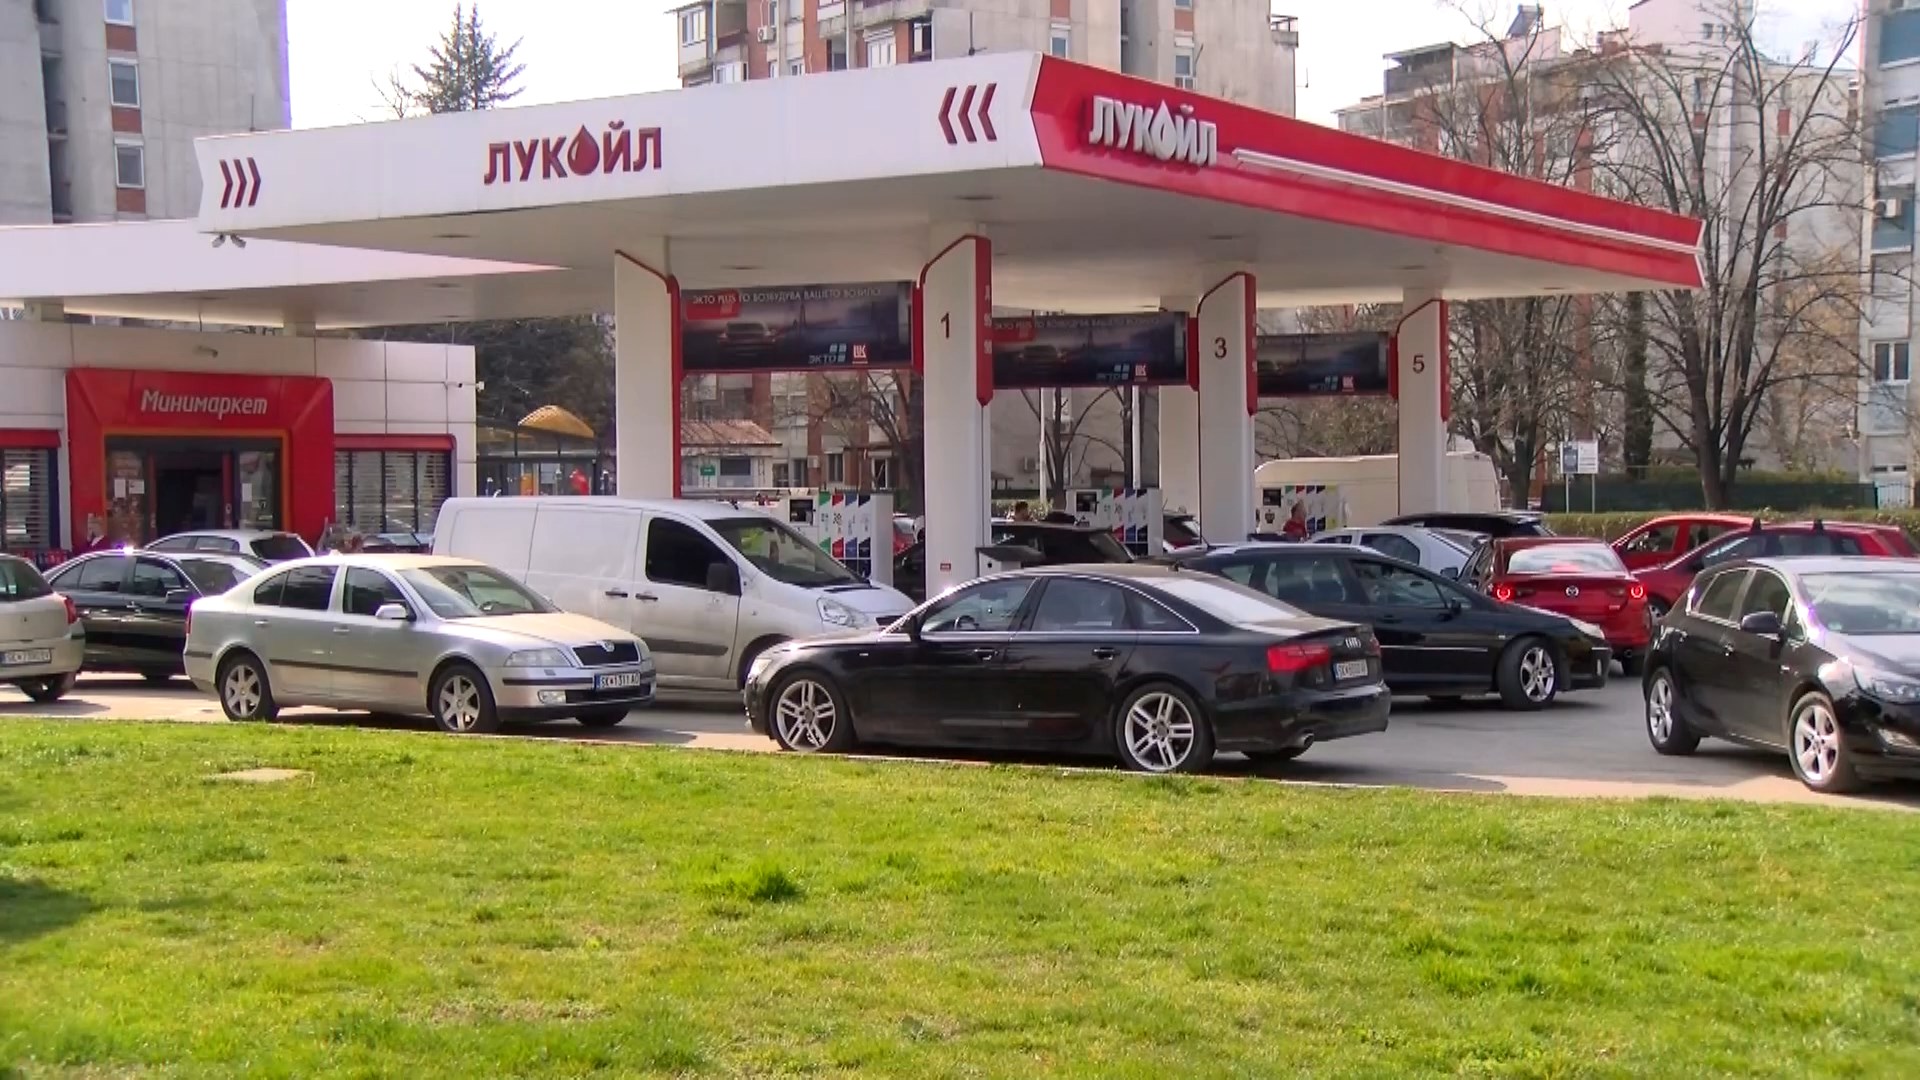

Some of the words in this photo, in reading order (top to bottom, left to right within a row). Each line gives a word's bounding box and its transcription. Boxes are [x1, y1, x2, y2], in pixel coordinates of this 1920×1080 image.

[1089, 95, 1217, 167] ЛУКОЙЛ
[484, 119, 662, 185] ЛУКОЙЛ
[940, 312, 950, 339] 1
[1214, 337, 1227, 359] 3
[1412, 355, 1425, 374] 5
[140, 389, 268, 421] Минимаркет
